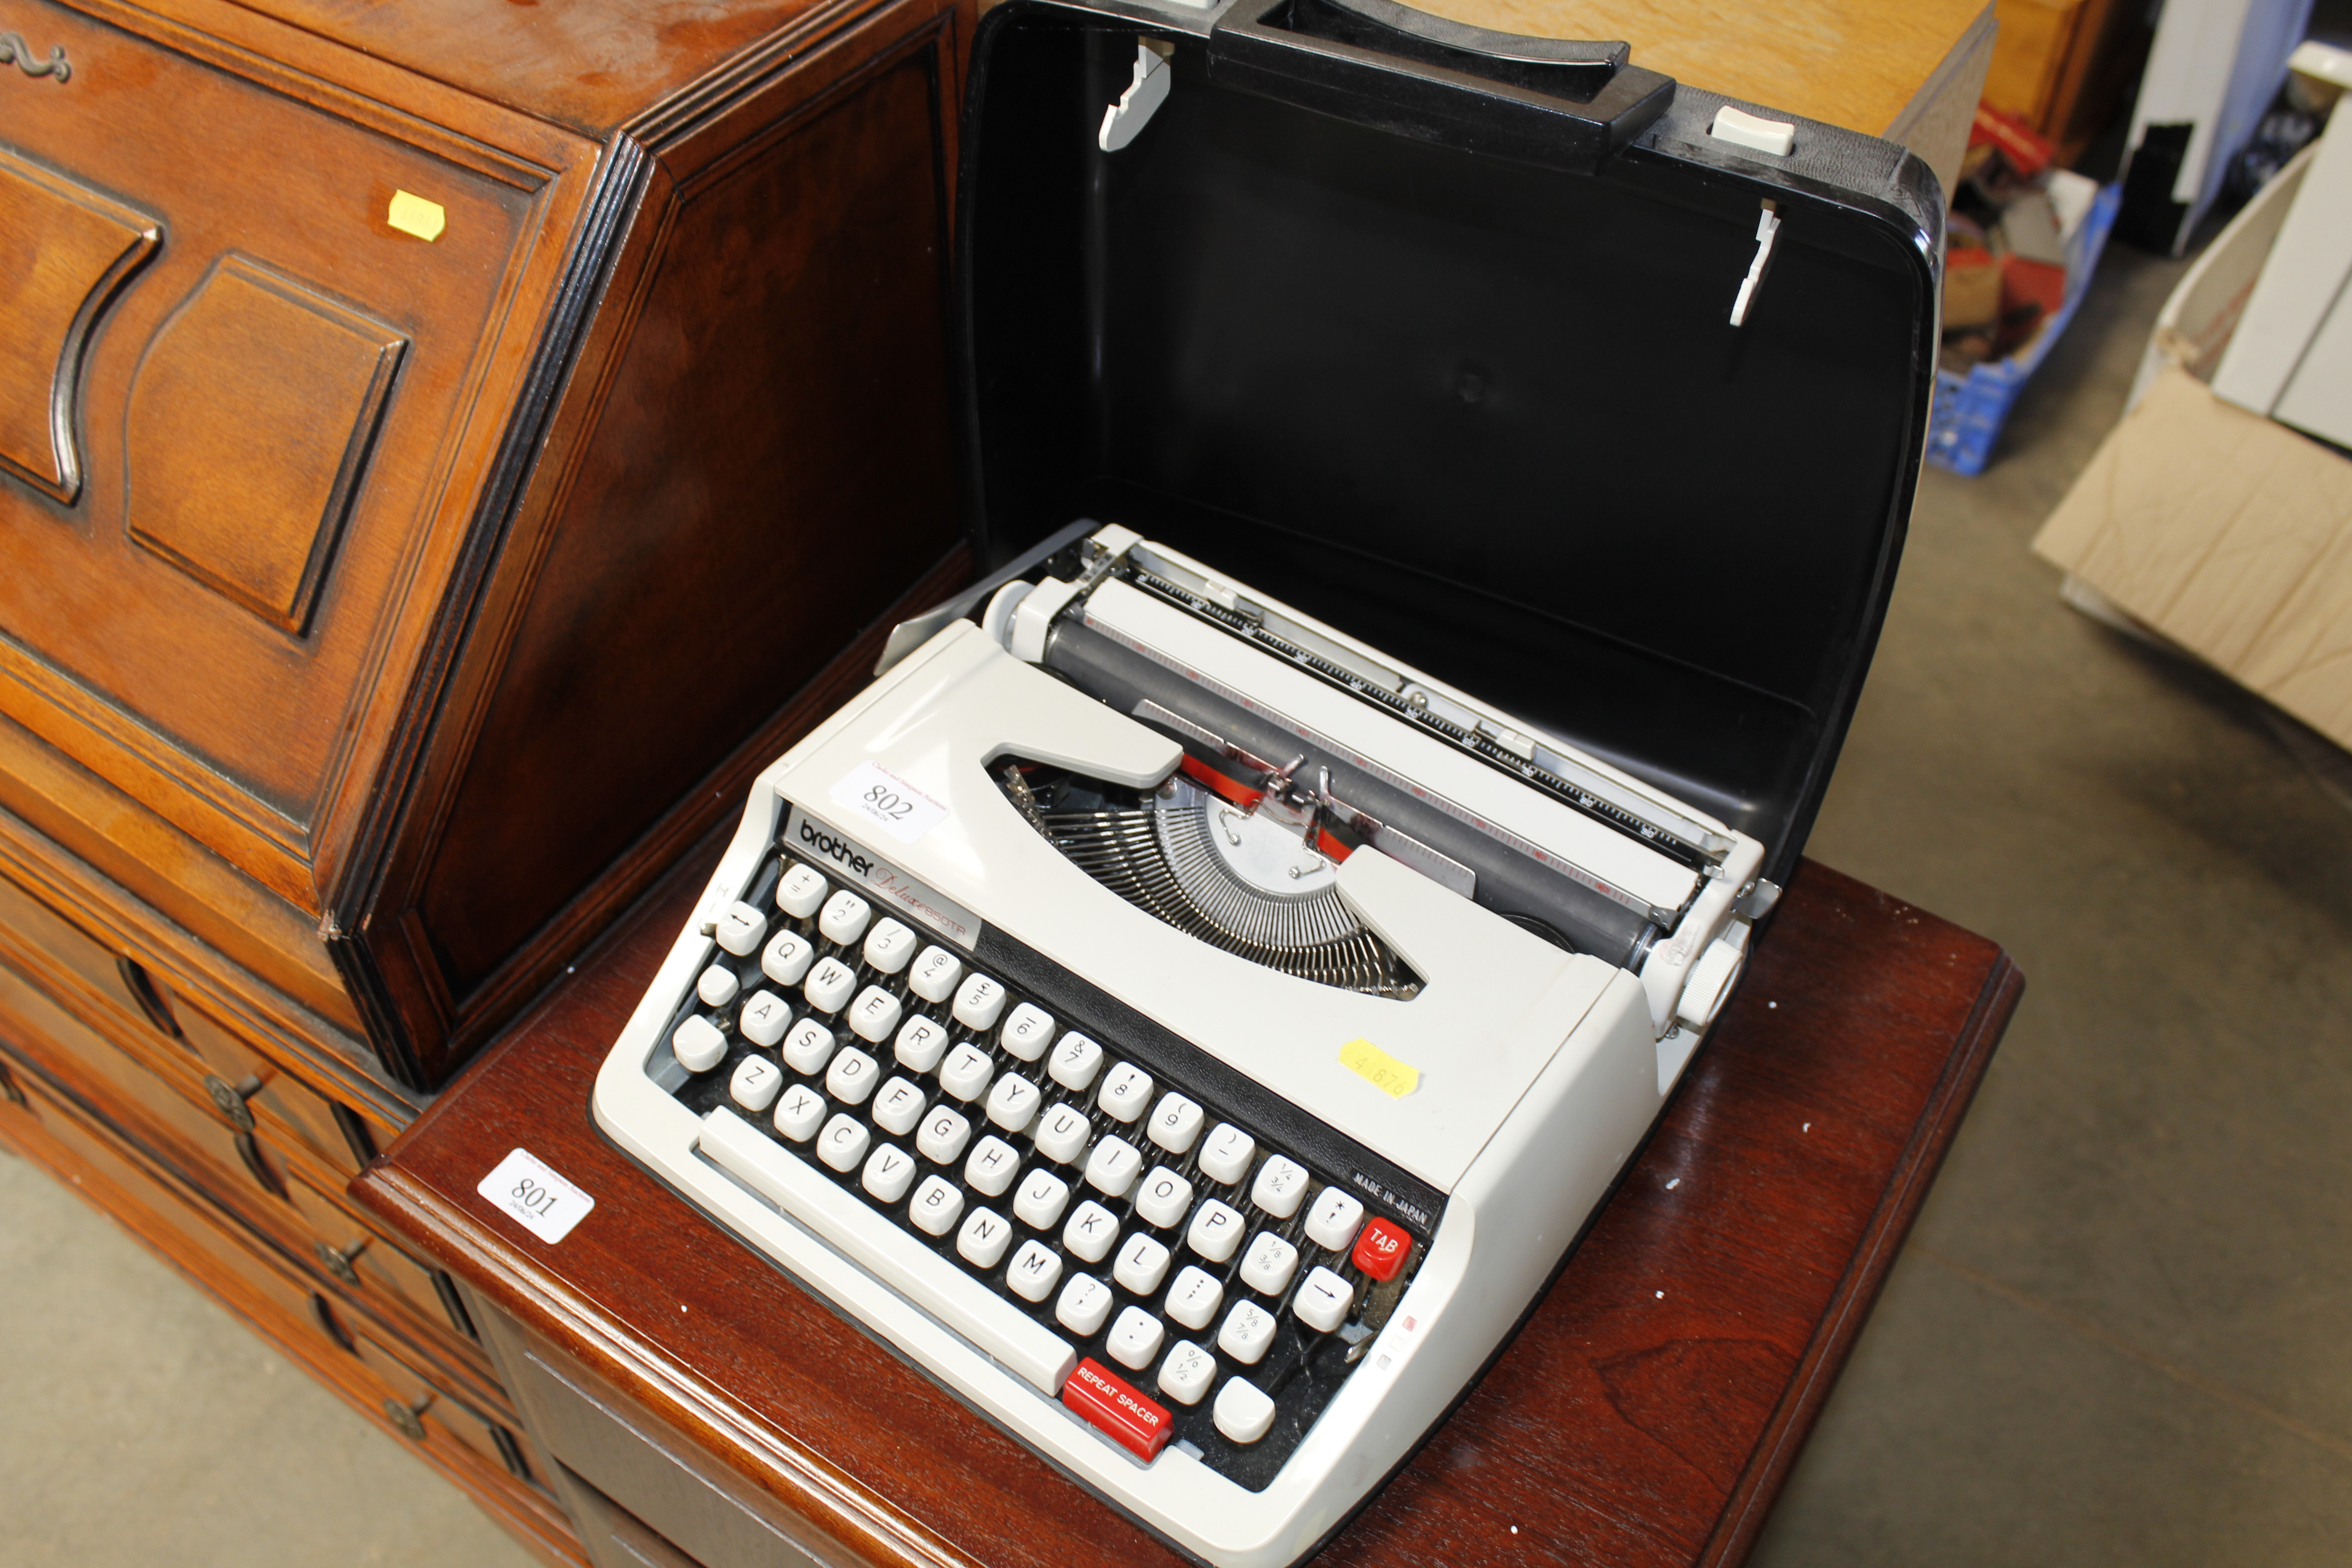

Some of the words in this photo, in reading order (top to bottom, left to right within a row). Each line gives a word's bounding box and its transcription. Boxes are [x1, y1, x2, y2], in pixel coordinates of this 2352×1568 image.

[1462, 737, 1475, 748] 60
[1522, 766, 1534, 777] 70
[872, 761, 888, 774] Clarke
[890, 773, 901, 782] and
[900, 778, 922, 795] Simpson
[922, 793, 947, 811] Auctions
[864, 785, 913, 820] 802
[1579, 796, 1594, 808] 80
[862, 803, 889, 822] 24/06/24
[1641, 827, 1654, 839] 90
[800, 819, 874, 877] brother
[871, 867, 926, 910] Deluxe
[924, 906, 967, 936] 850TR
[833, 910, 846, 920] 2
[778, 942, 795, 959] Q
[878, 938, 891, 948] 3
[933, 955, 947, 967] @
[819, 966, 842, 986] W
[924, 968, 933, 978] 4
[976, 983, 990, 996] £
[866, 997, 885, 1014] E
[969, 995, 981, 1004] 5
[755, 1004, 771, 1019] A
[910, 1027, 930, 1045] R
[1017, 1023, 1030, 1034] 6
[799, 1031, 816, 1047] S
[1074, 1040, 1085, 1054] &
[961, 1054, 977, 1070] T
[1064, 1050, 1079, 1062] 7
[745, 1066, 764, 1084] Z
[842, 1058, 861, 1075] D
[888, 1088, 908, 1102] F
[1007, 1084, 1024, 1102] Y
[1115, 1084, 1127, 1095] 8
[789, 1096, 810, 1115] X
[934, 1119, 952, 1137] G
[1054, 1115, 1074, 1133] U
[1165, 1114, 1178, 1126] 9
[834, 1127, 852, 1143] C
[882, 1155, 899, 1173] V
[981, 1149, 1003, 1168] H
[1107, 1150, 1120, 1165] I
[512, 1178, 557, 1217] 801
[926, 1188, 945, 1206] B
[1033, 1186, 1051, 1199] J
[1155, 1181, 1173, 1198] O
[1352, 1172, 1383, 1197] MADE
[1383, 1191, 1396, 1205] IN
[1396, 1200, 1428, 1225] JAPAN
[1080, 1213, 1102, 1233] K
[1205, 1211, 1226, 1227] P
[973, 1219, 995, 1240] N
[1371, 1228, 1398, 1252] TAB
[1023, 1252, 1046, 1274] M
[1133, 1246, 1147, 1265] L
[1078, 1367, 1118, 1397] REPEAT
[1117, 1394, 1159, 1427] SPACER
